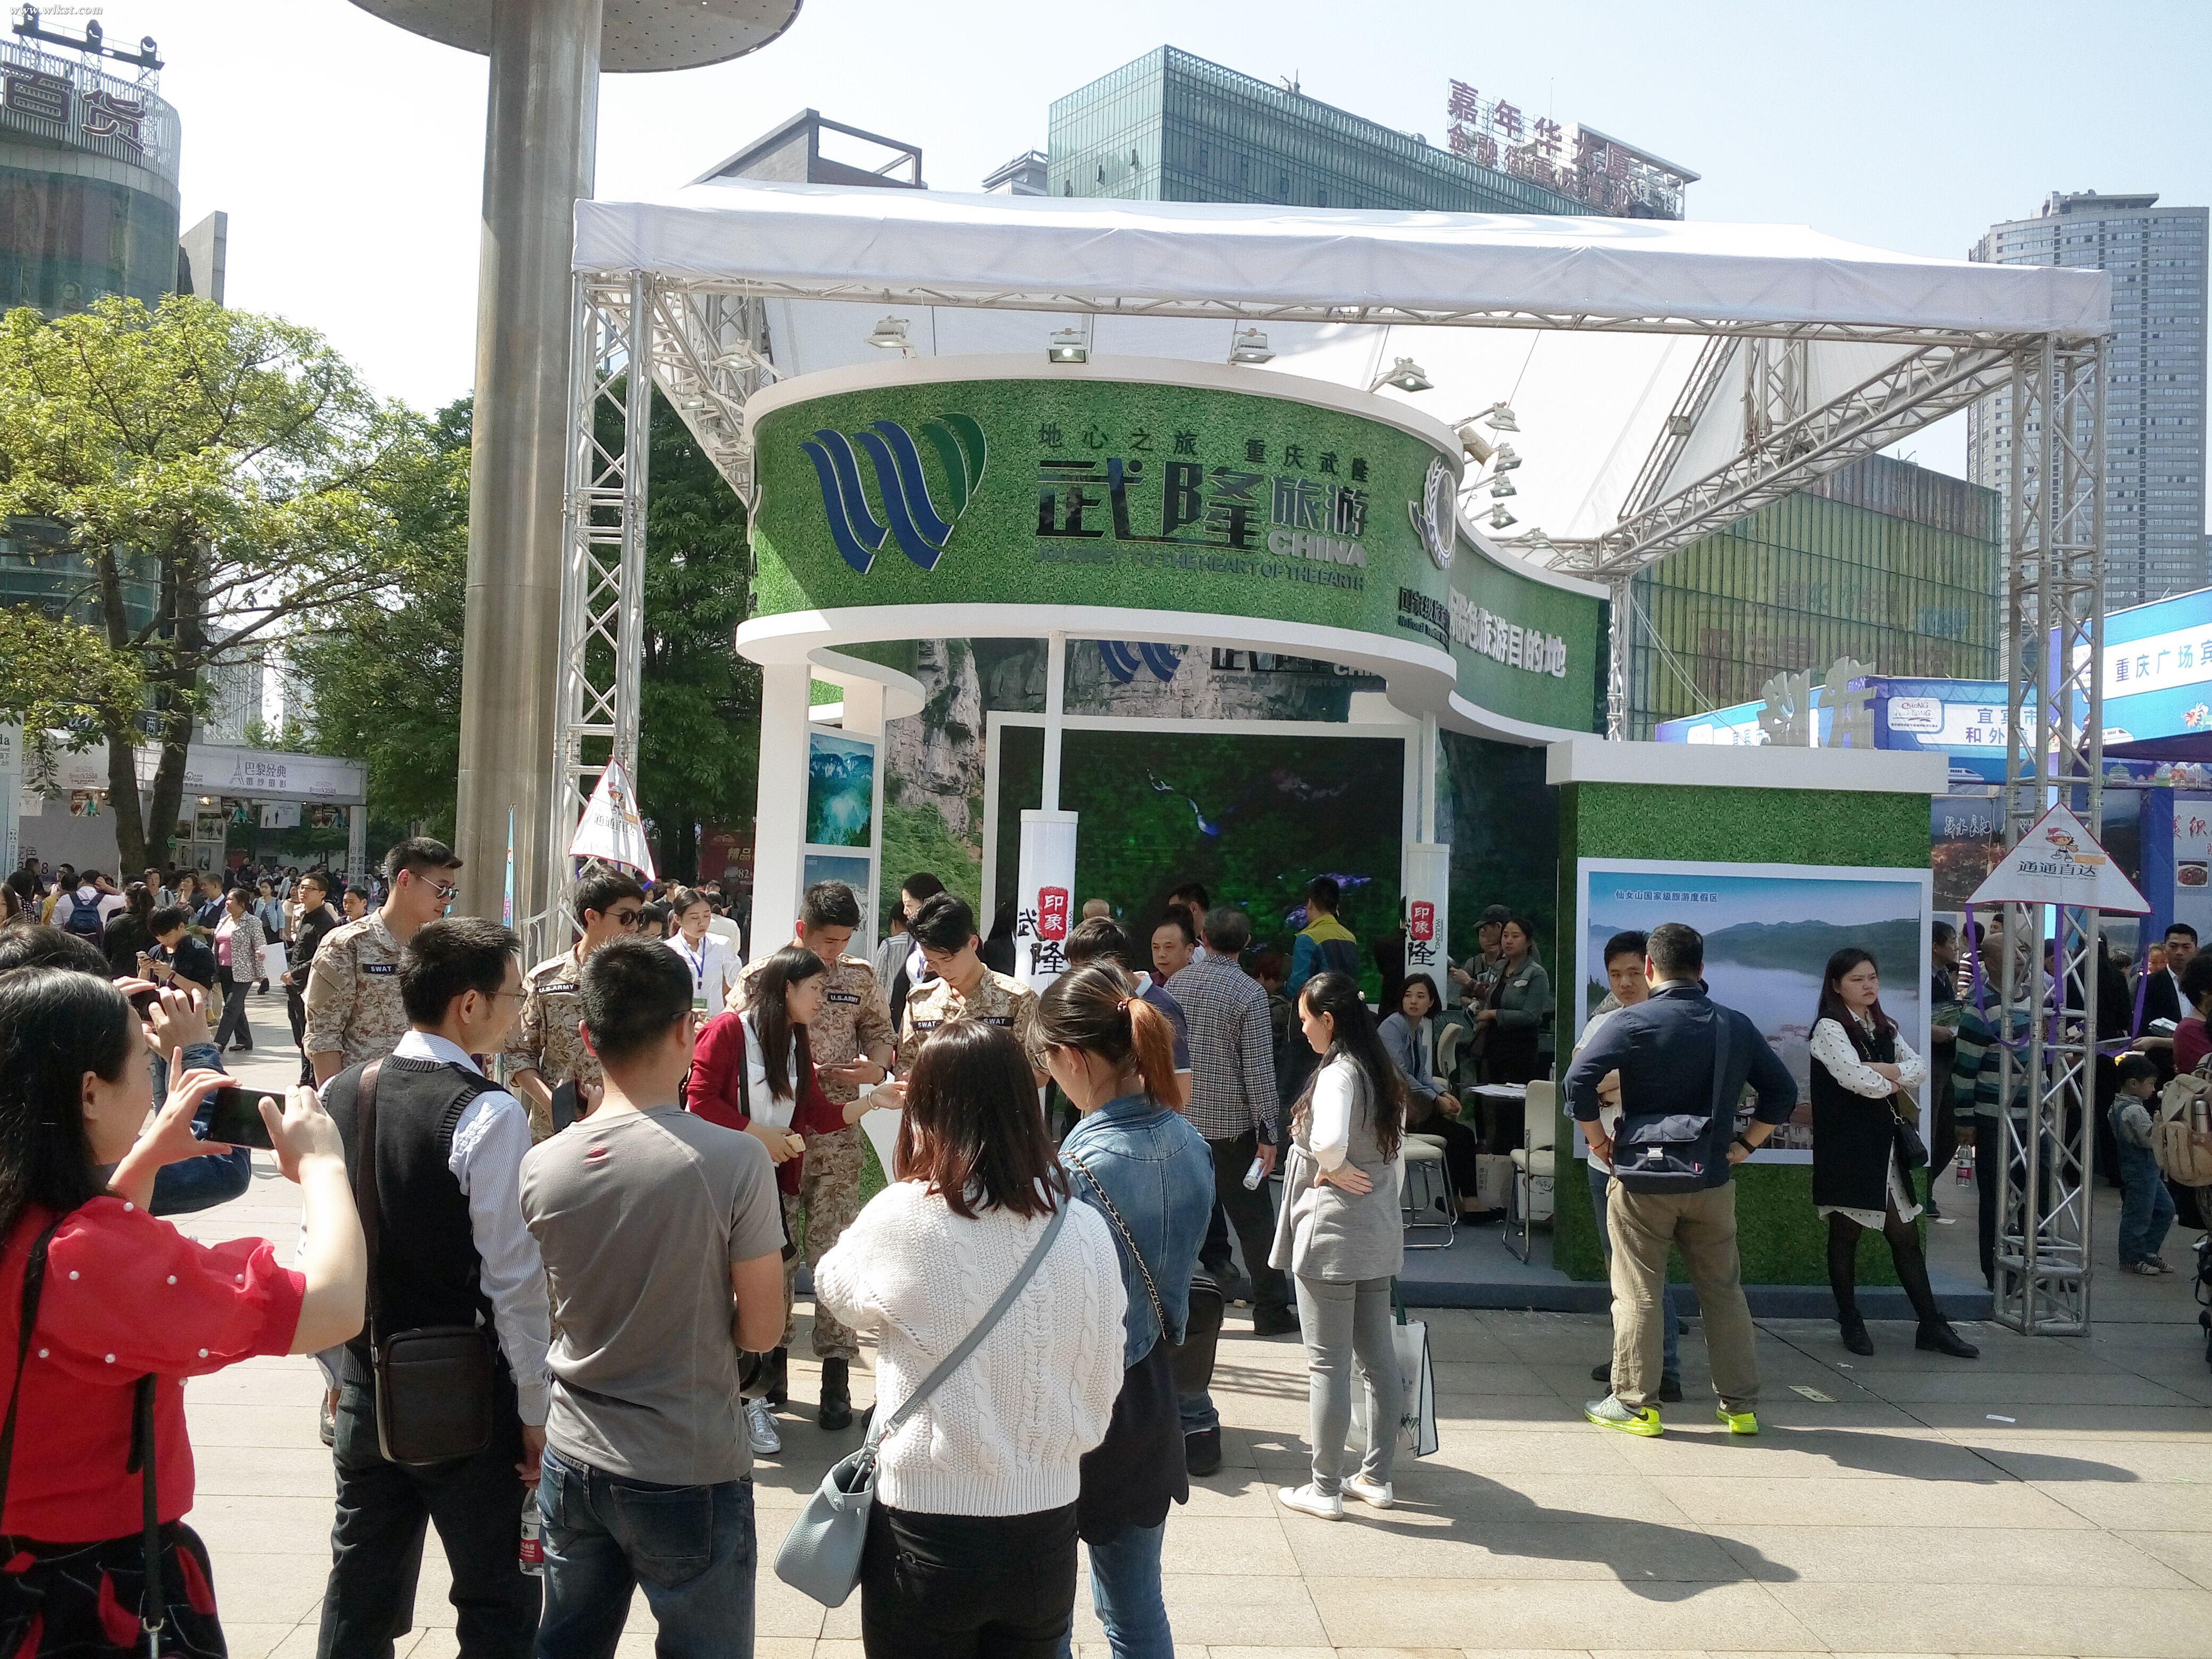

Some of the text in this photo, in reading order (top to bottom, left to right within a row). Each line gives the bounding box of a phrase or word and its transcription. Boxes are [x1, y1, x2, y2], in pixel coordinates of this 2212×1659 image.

[1448, 78, 1631, 183] 嘉年华大厦
[1038, 424, 1368, 482] 地心之旅 重庆武隆
[1268, 530, 1367, 568] CHINA
[1159, 552, 1196, 569] THE
[1200, 556, 1261, 575] HEART
[1262, 564, 1286, 577] OF
[1288, 564, 1318, 583] THE
[1318, 568, 1364, 591] EARTH
[245, 761, 286, 777] 巴黎经典
[2017, 860, 2098, 877] 通通直达
[1043, 894, 1064, 931] 印象
[1615, 889, 1718, 902] 仙女山国家级旅游度假区
[1414, 907, 1430, 934] 印象
